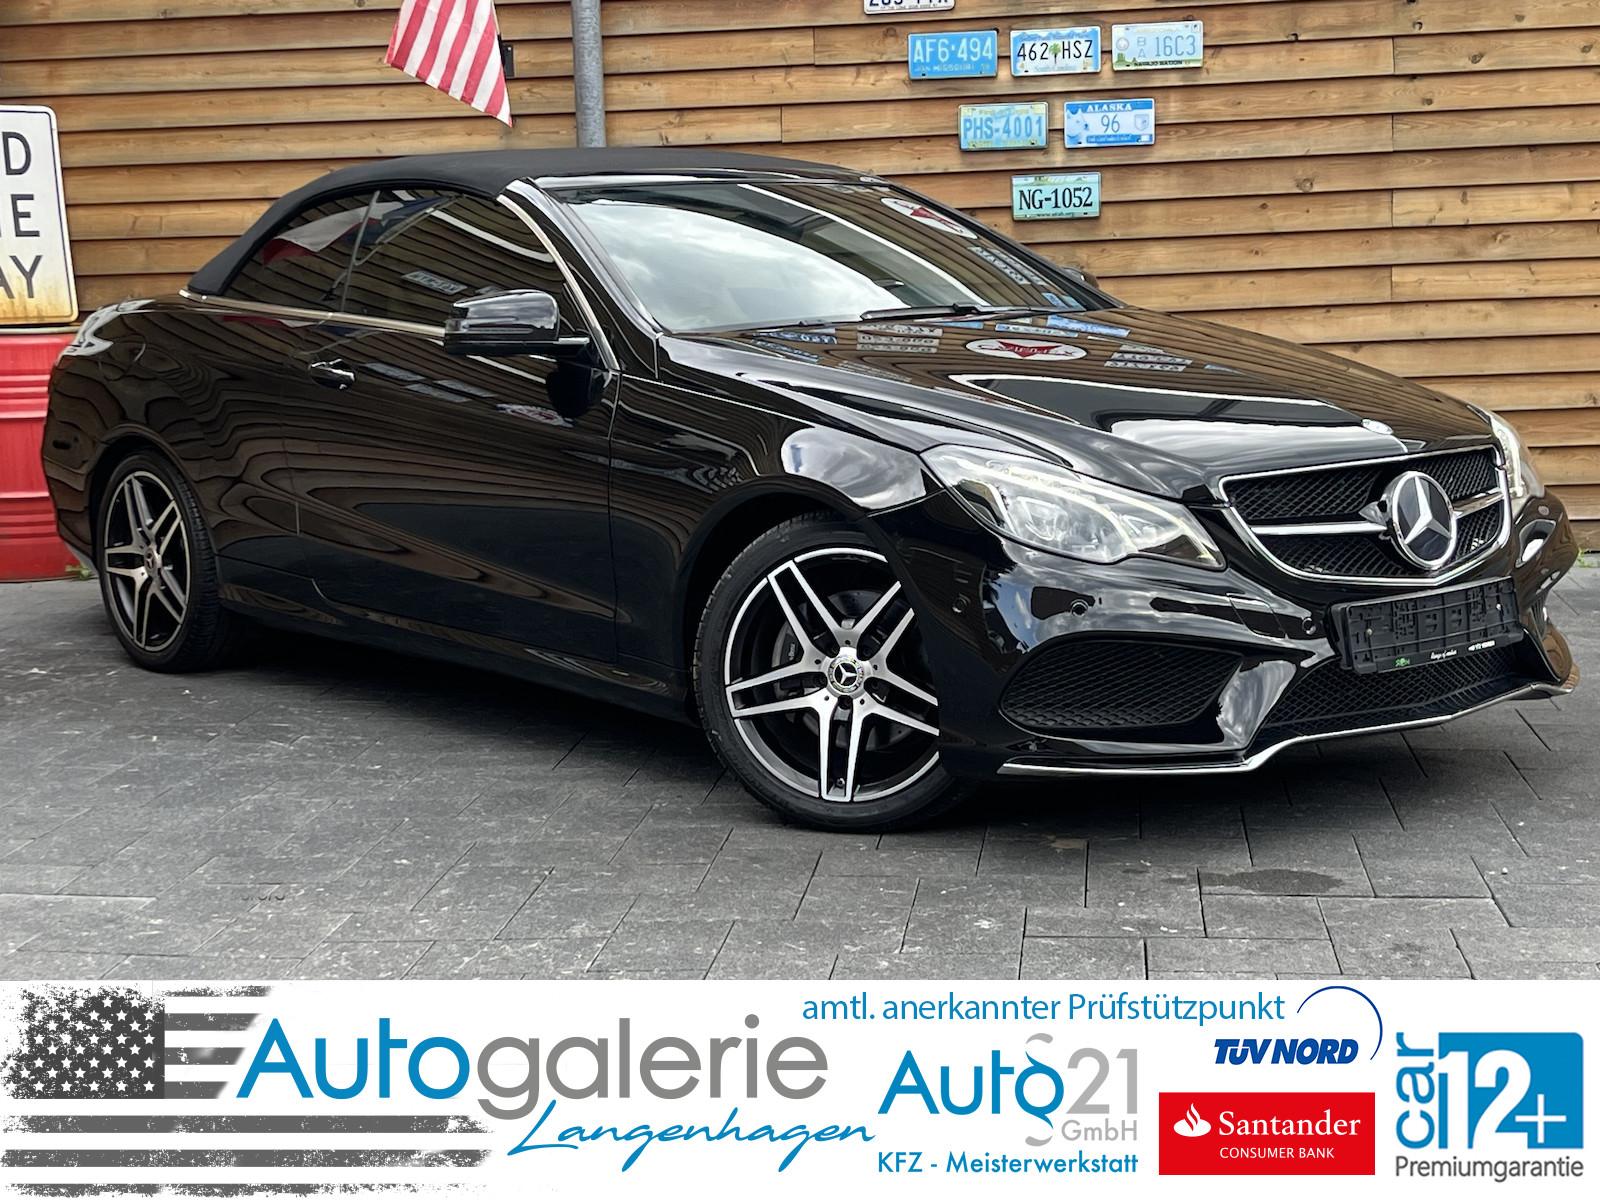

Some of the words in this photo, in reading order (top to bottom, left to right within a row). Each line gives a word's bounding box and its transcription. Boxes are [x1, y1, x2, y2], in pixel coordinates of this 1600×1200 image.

[1017, 42, 1048, 61] 462
[1062, 40, 1092, 59] HSZ
[1087, 103, 1132, 113] ALASKA
[963, 116, 1042, 139] PHS-4001
[1101, 114, 1120, 134] 96
[1019, 187, 1093, 210] NG-1052
